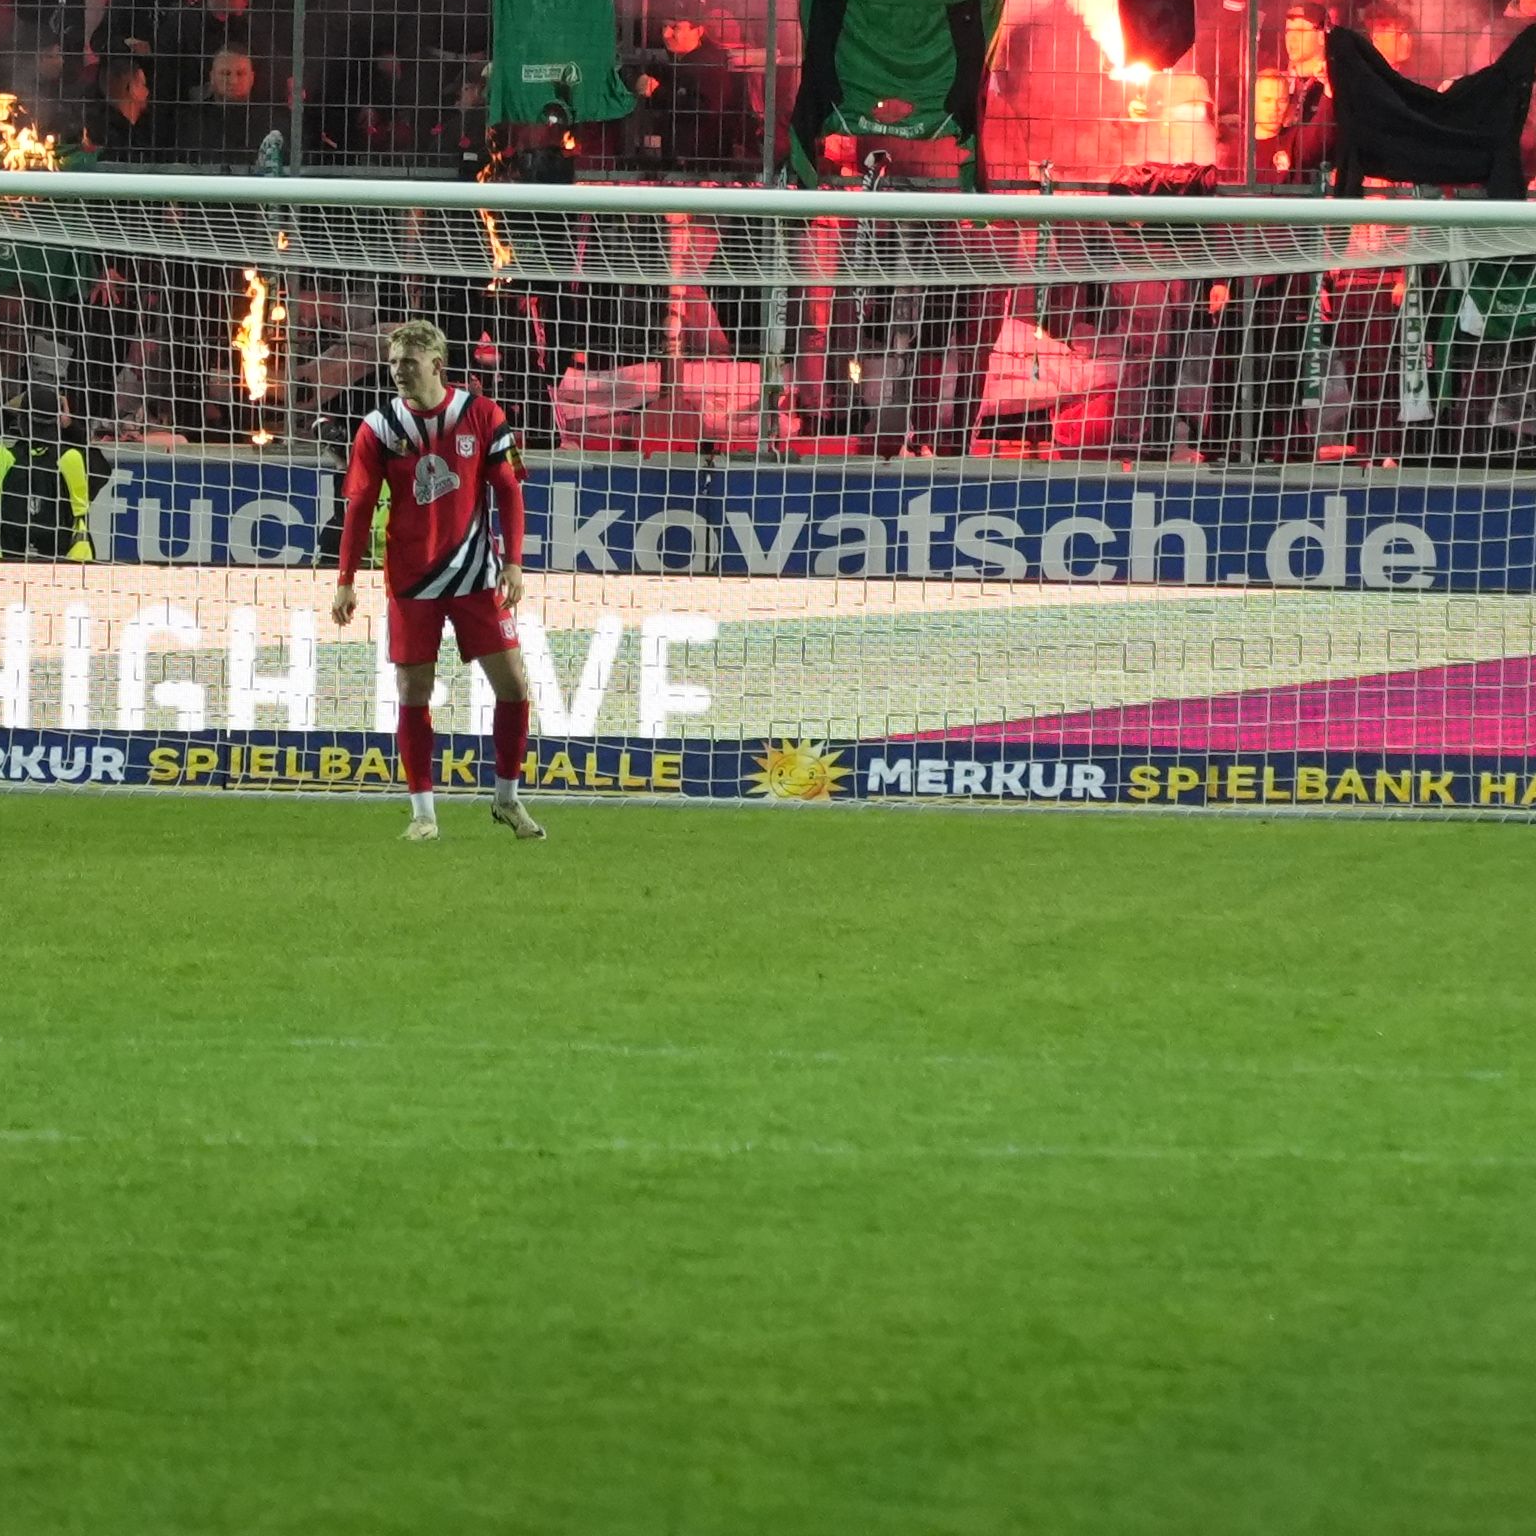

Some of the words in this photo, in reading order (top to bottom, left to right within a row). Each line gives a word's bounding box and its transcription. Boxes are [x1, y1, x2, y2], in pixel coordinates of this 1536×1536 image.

[147, 745, 477, 785] SPIELBAK
[867, 757, 1107, 800] MERKUR
[1128, 765, 1455, 804] SPIELBANK
